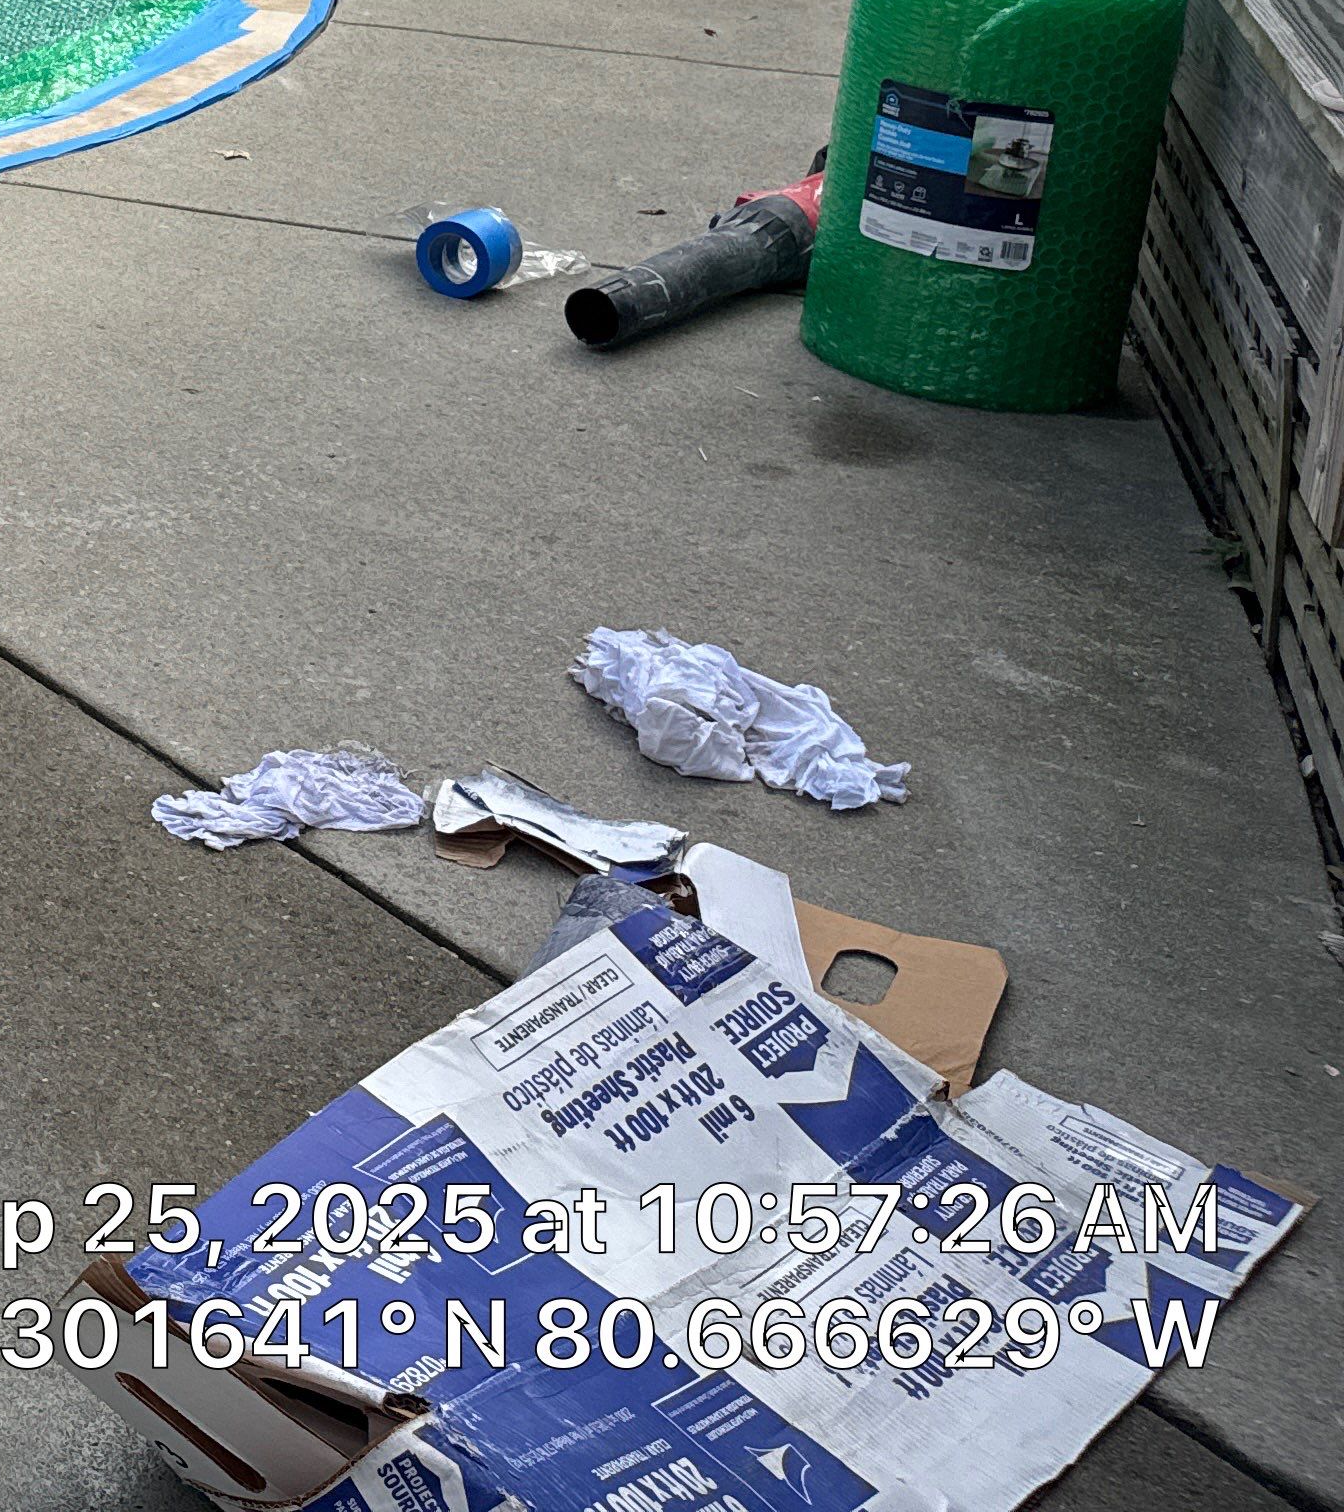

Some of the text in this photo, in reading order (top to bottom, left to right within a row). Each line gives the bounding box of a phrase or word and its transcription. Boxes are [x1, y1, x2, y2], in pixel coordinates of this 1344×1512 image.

[582, 966, 618, 996] CLEAR
[493, 990, 582, 1052] TRANSPARENTE
[748, 1013, 816, 1068] PROJECT
[500, 999, 668, 1118] Láminas de plástico
[539, 1030, 696, 1142] Plastic Sheeting
[603, 1061, 725, 1155] 20 ft x 100 ft
[698, 1094, 755, 1145] 6 mil
[937, 1159, 968, 1183] PARA
[854, 1245, 933, 1307] Láminas
[892, 1370, 929, 1404] ft
[636, 1474, 672, 1503] x
[649, 1467, 695, 1500] ft
[667, 1455, 718, 1496] 20
